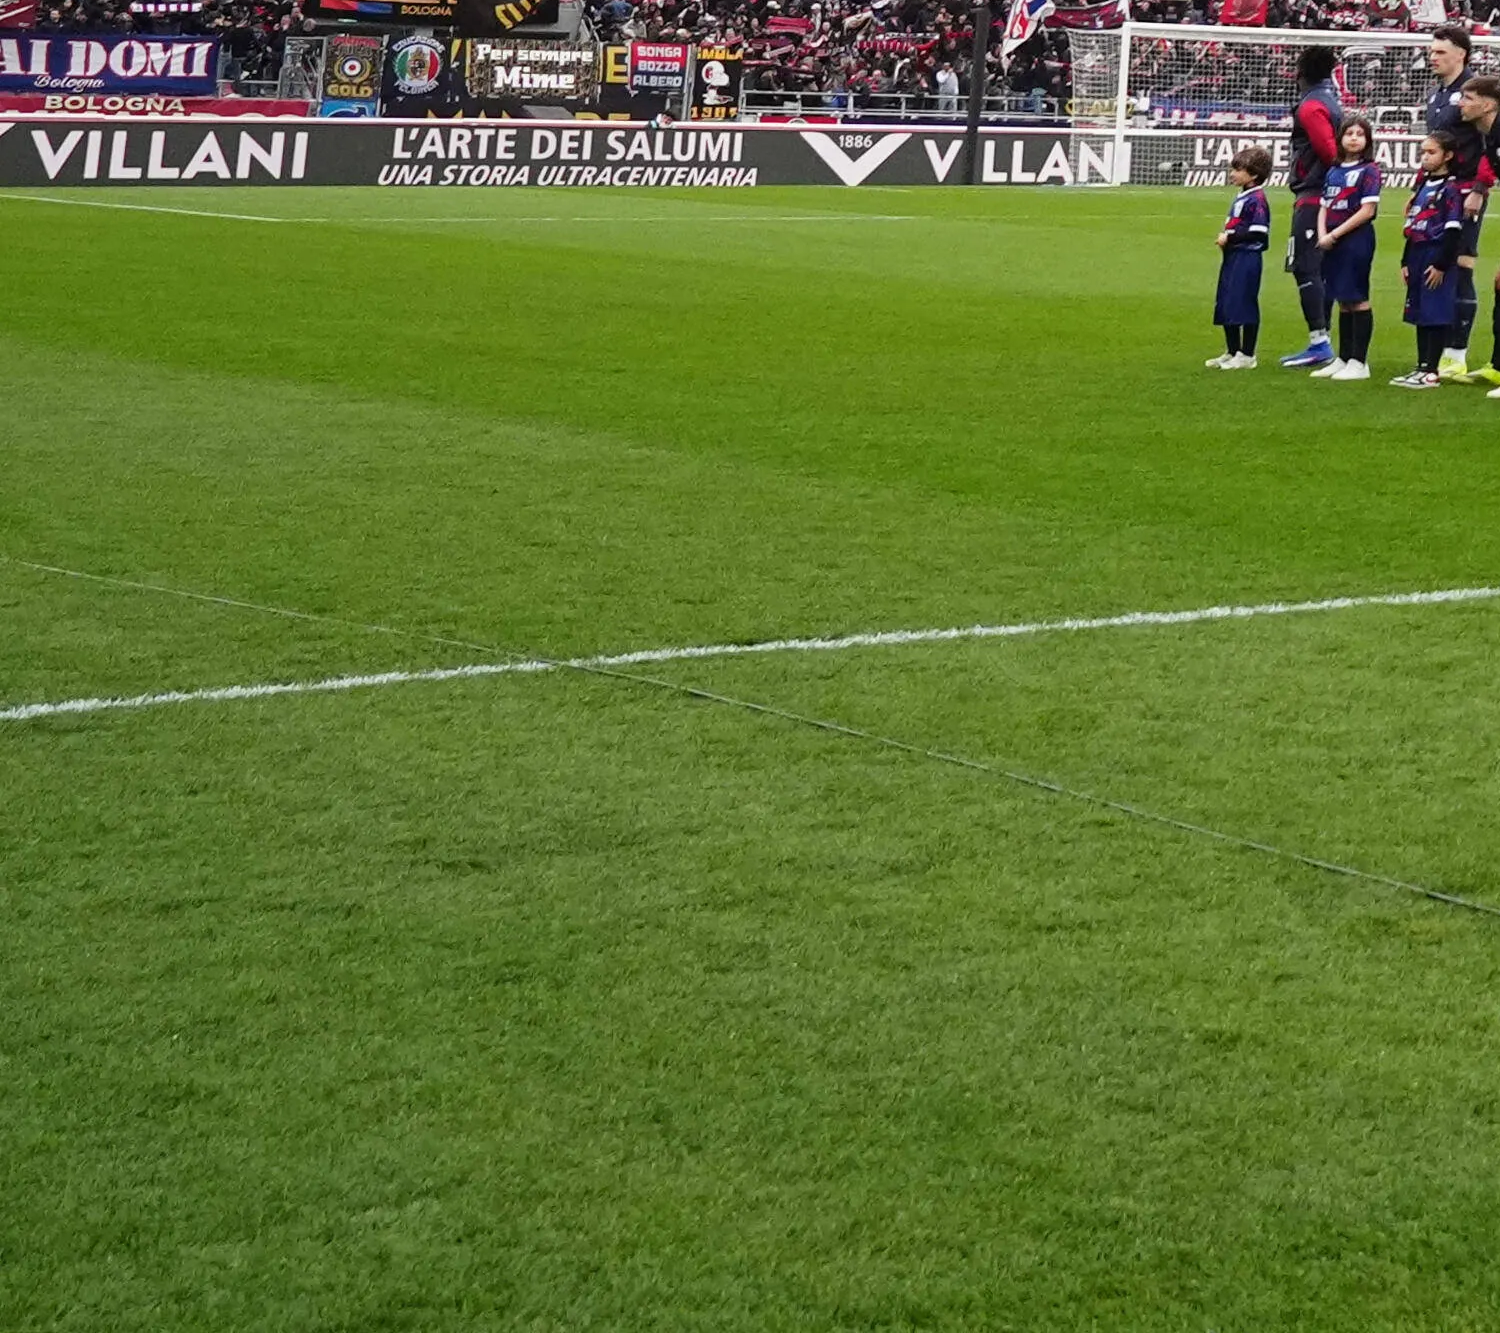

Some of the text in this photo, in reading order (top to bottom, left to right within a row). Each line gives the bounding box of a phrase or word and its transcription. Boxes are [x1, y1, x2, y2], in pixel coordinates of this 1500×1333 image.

[401, 5, 451, 17] BOLOGNA
[66, 39, 214, 77] DOMI
[476, 44, 593, 64] Per sempre
[637, 46, 682, 57] SONGA
[638, 61, 680, 72] BOZZA
[34, 74, 105, 93] Bologna
[494, 66, 575, 90] Mime
[632, 75, 682, 87] ALBERO
[326, 84, 373, 98] GOLD
[44, 95, 185, 112] BOLOGNA
[392, 127, 743, 163] L'ARTE DEI SALUMI
[838, 135, 873, 149] 1886
[30, 130, 309, 180] VILLANI
[924, 140, 1132, 183] VLLANI
[377, 165, 758, 188] UNA STORIA ULTRACENTENARIA
